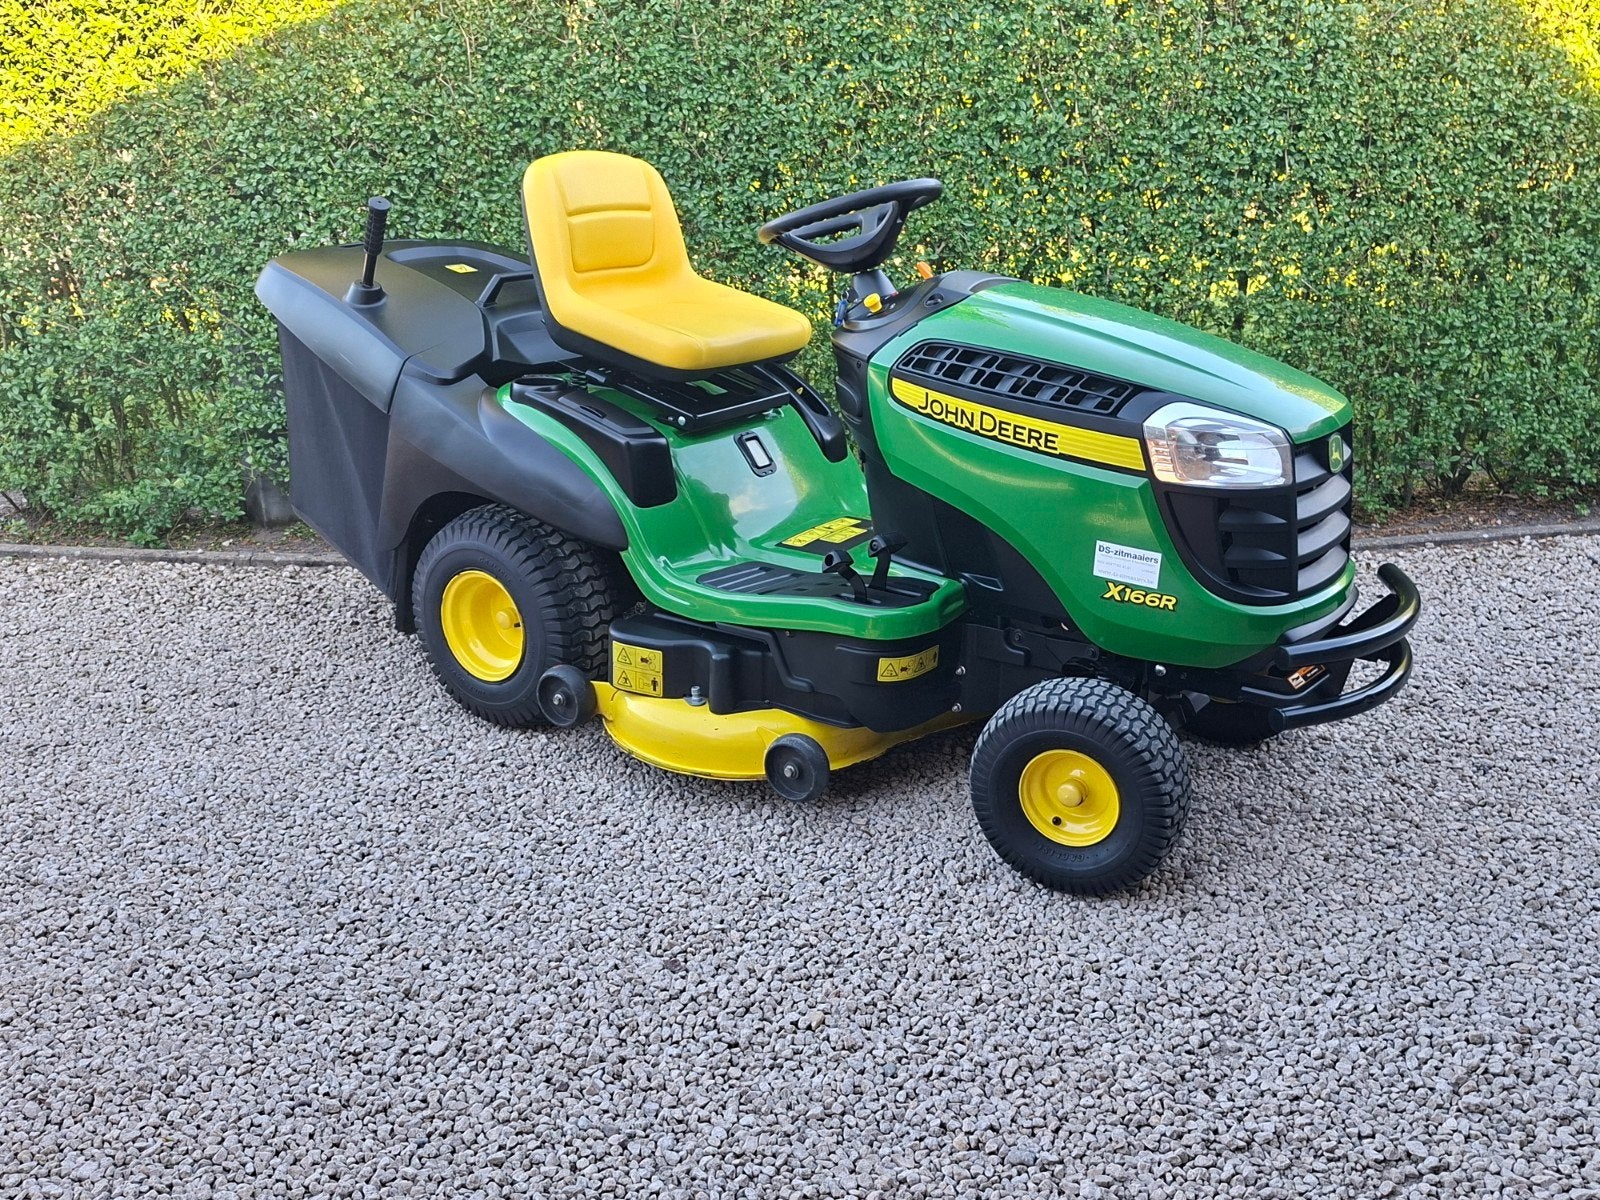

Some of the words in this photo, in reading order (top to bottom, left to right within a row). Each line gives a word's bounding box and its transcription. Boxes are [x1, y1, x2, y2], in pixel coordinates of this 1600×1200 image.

[918, 391, 975, 428] JOHN
[979, 410, 1059, 451] DEERE
[1098, 544, 1159, 565] DS-zitmaaiers
[1102, 581, 1177, 611] X166R
